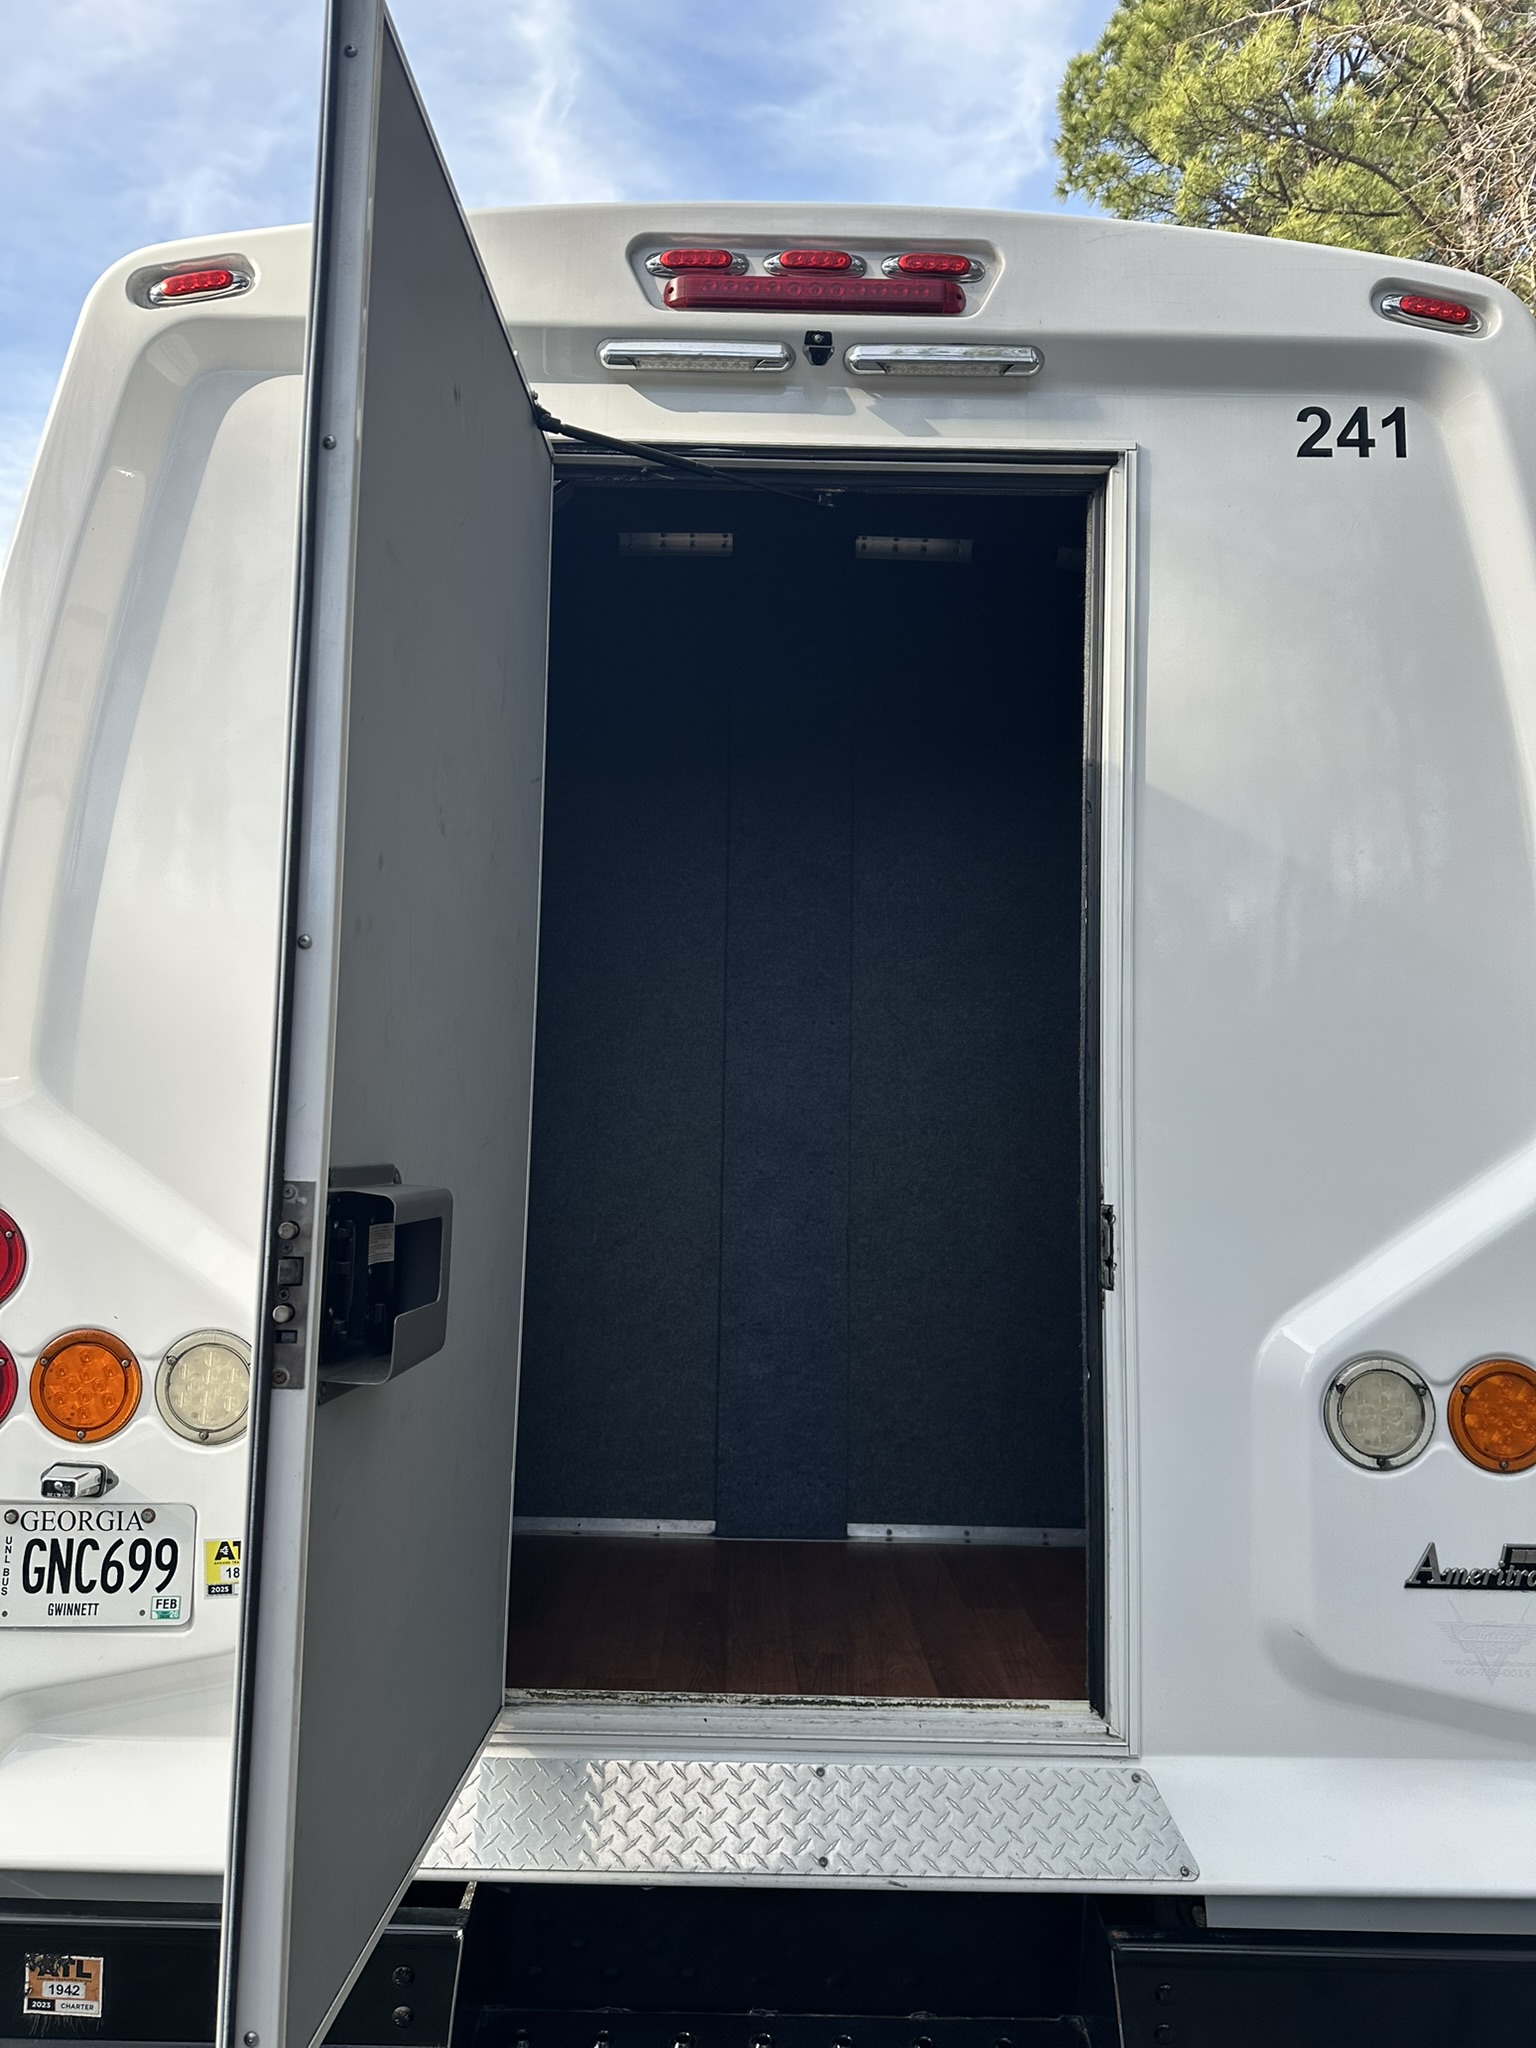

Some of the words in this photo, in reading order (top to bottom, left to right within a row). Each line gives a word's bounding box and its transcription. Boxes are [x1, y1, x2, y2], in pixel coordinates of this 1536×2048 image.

[1296, 406, 1407, 458] 241
[20, 1510, 145, 1532] GEORGIA
[4, 1536, 13, 1564] UNL
[22, 1538, 179, 1595] GNC699
[226, 1567, 240, 1579] 18
[1, 1567, 10, 1596] BUS
[211, 1585, 229, 1594] 2025
[47, 1603, 100, 1616] GWINNETT
[155, 1598, 177, 1609] FEB
[48, 1984, 80, 1996] 1942
[60, 2003, 94, 2011] CHARTER
